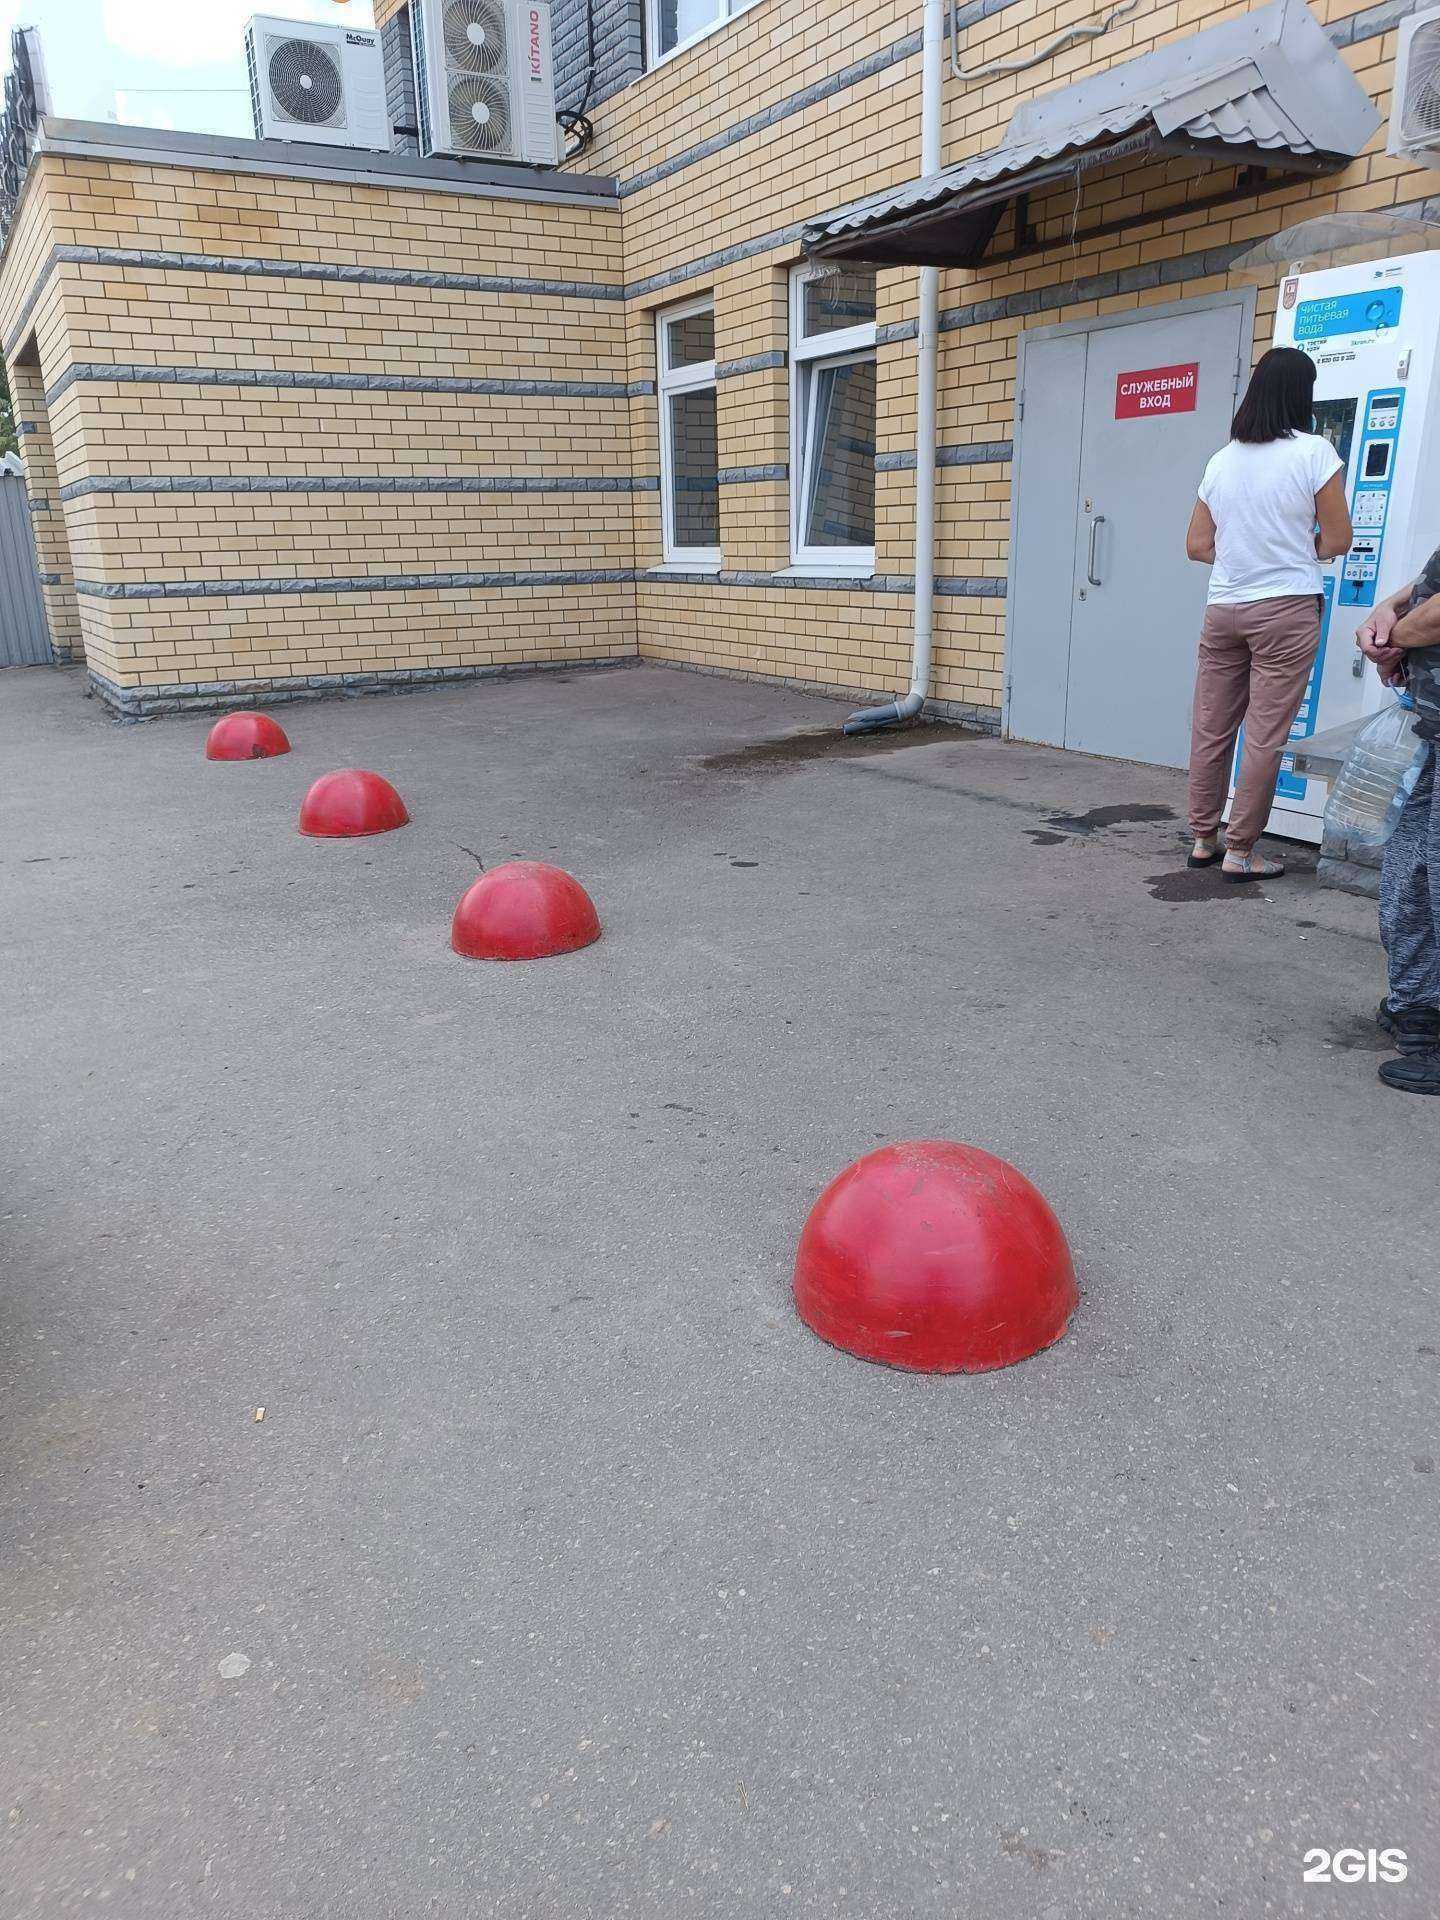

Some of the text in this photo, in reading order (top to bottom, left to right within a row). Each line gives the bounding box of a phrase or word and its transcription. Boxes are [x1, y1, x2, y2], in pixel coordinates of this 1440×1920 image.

[346, 33, 375, 45] McQuay
[1120, 372, 1194, 395] СЛУЖЕБНЫЙ
[1139, 395, 1171, 409] ВХОД
